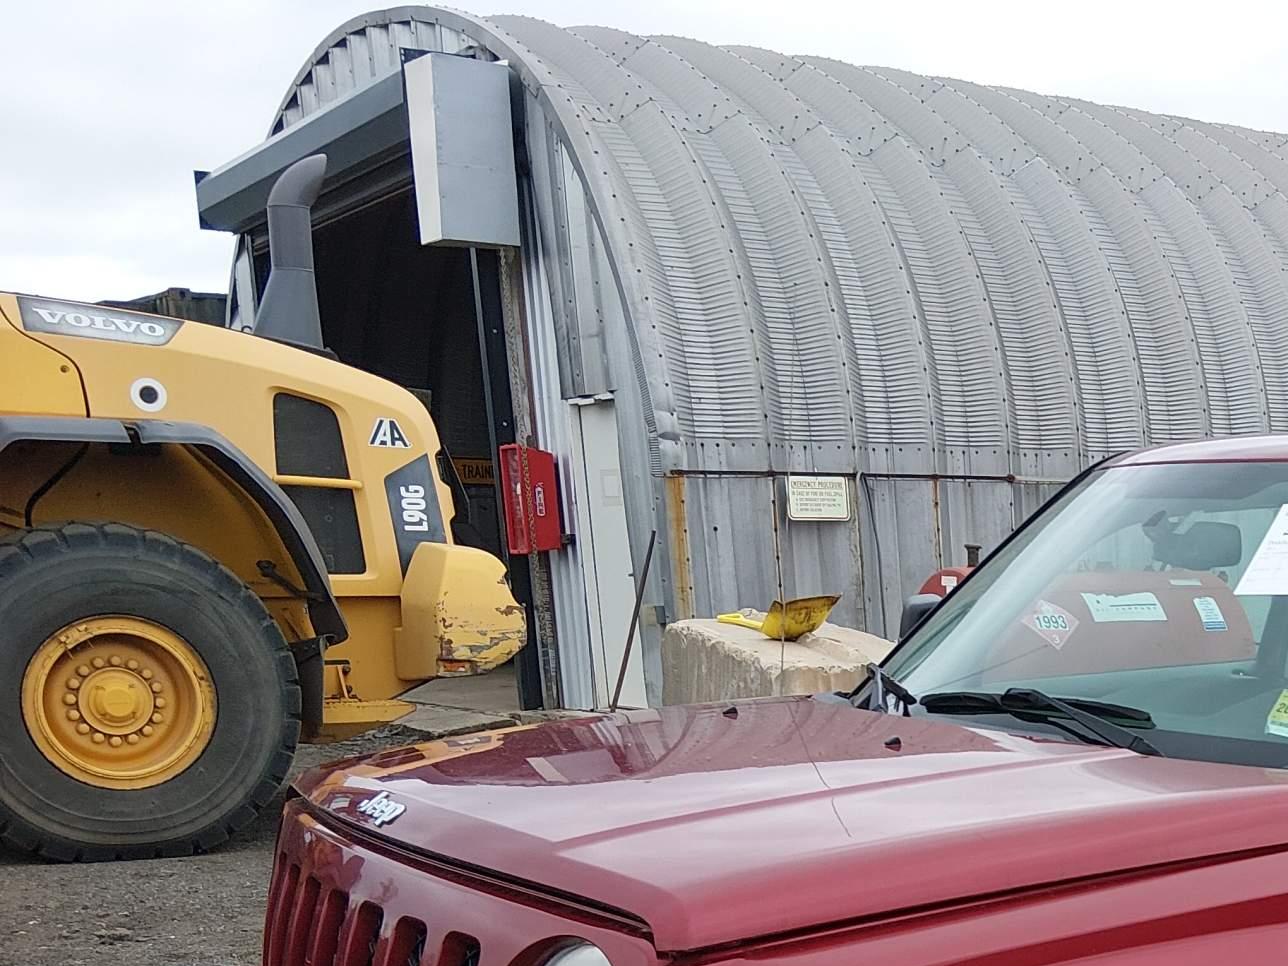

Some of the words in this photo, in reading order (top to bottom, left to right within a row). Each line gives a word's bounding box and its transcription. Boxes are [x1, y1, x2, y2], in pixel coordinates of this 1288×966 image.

[32, 307, 165, 337] VOLVO
[400, 485, 429, 532] L90G
[1036, 615, 1067, 629] 1993
[357, 791, 405, 826] Jeep
